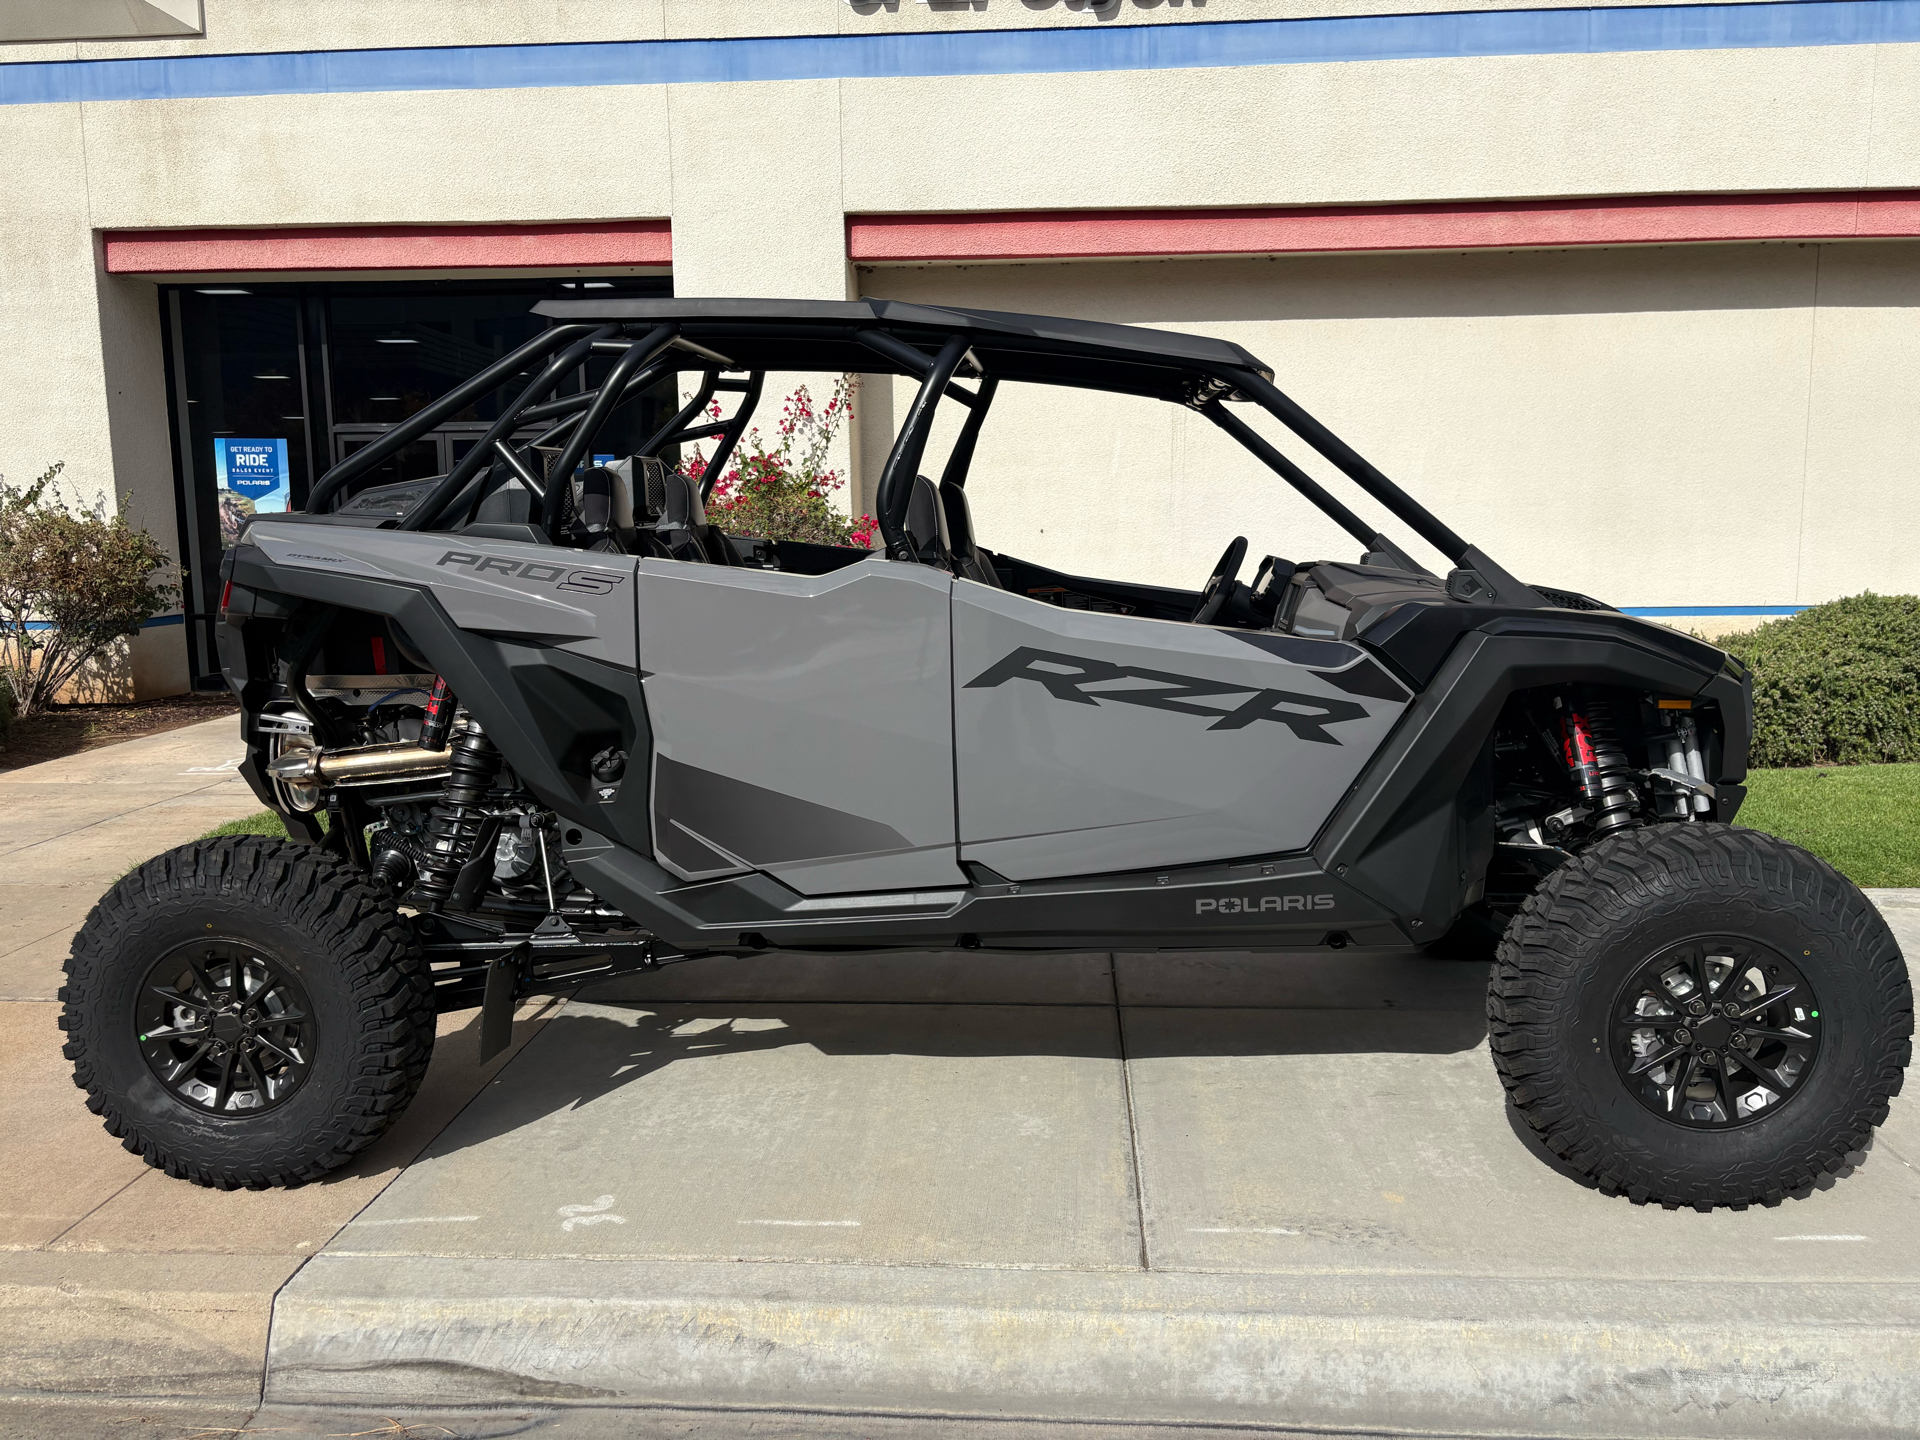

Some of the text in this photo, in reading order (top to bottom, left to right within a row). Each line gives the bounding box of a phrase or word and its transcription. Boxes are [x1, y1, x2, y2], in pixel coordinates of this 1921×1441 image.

[236, 454, 268, 466] RIDE
[436, 550, 626, 596] PRO S
[961, 645, 1371, 746] RZR
[1195, 894, 1336, 915] POLARIS
